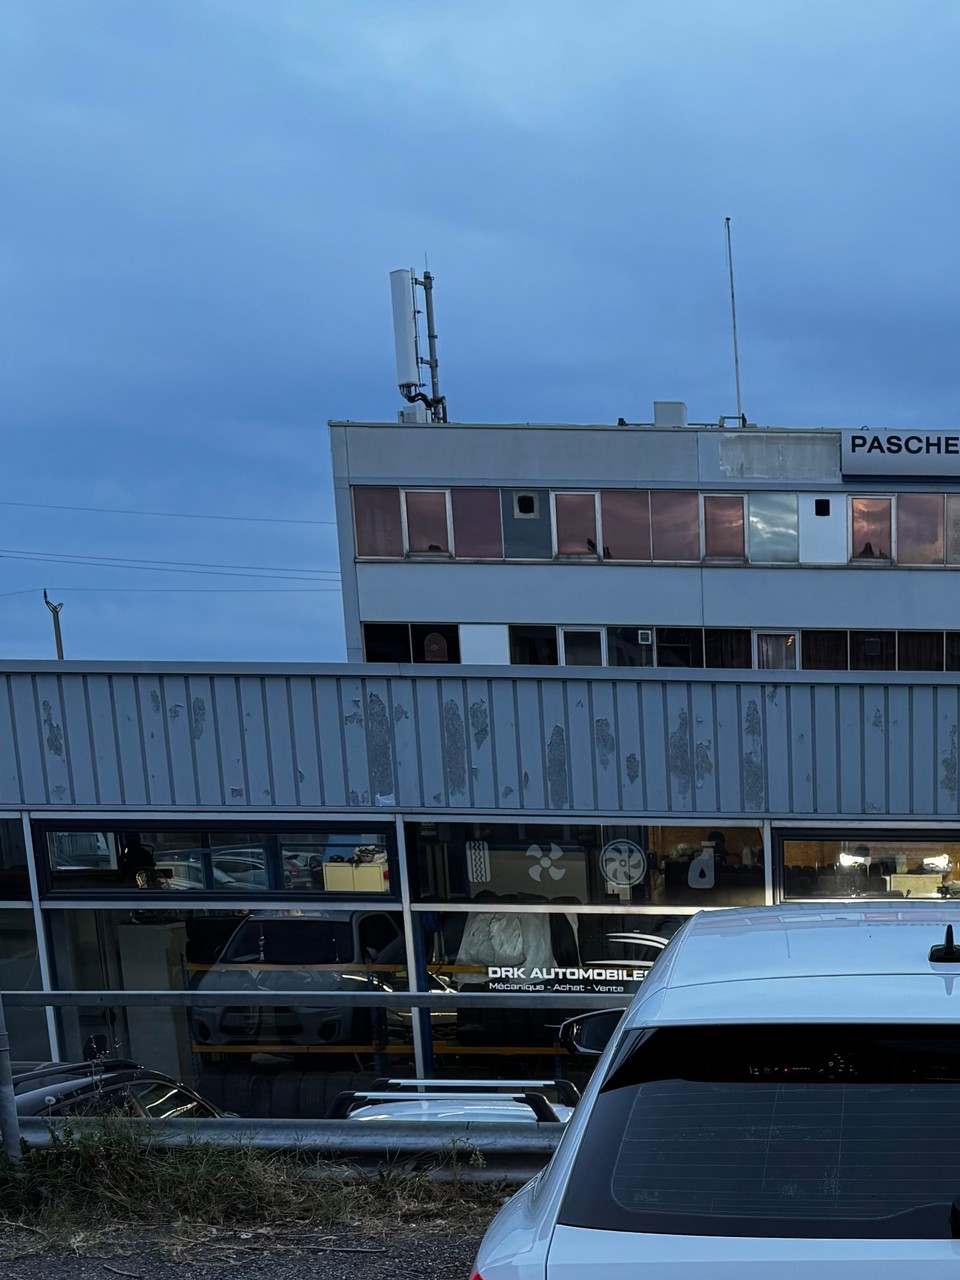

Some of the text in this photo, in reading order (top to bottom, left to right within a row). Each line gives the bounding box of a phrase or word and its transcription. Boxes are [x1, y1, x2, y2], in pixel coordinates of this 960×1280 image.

[851, 435, 960, 454] PASCHE
[488, 967, 527, 979] DRK
[489, 982, 545, 992] Mécanique
[553, 983, 585, 992] Achat
[593, 984, 624, 993] Vente
